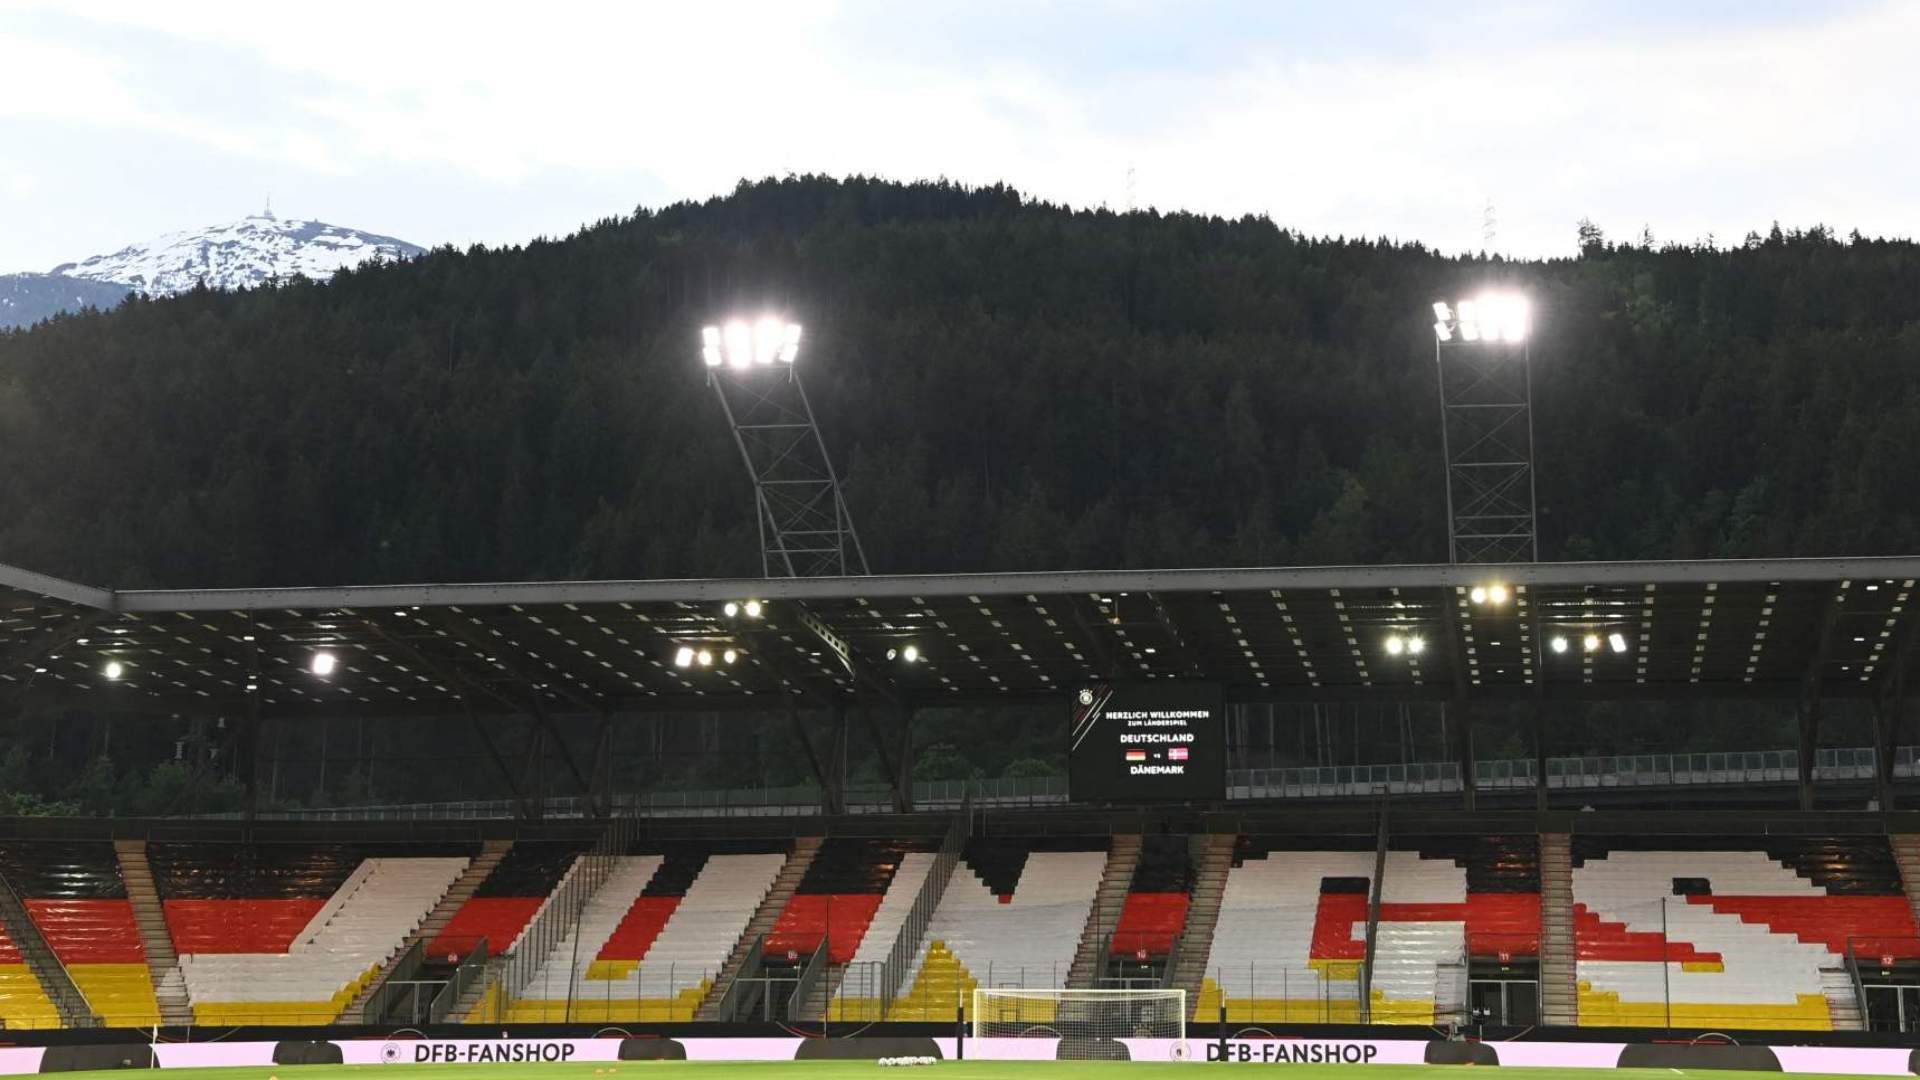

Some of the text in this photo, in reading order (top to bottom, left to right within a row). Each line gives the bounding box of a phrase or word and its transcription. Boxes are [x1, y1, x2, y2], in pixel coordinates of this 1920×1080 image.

[1105, 710, 1210, 720] HERZLICH WILLKOMMEN
[1120, 733, 1194, 743] DEUTSCHLAND
[1130, 764, 1185, 775] DÄNEMARK
[415, 1043, 575, 1062] DFB-FANSHOP
[1206, 1043, 1377, 1063] DFB-FANSHOP
